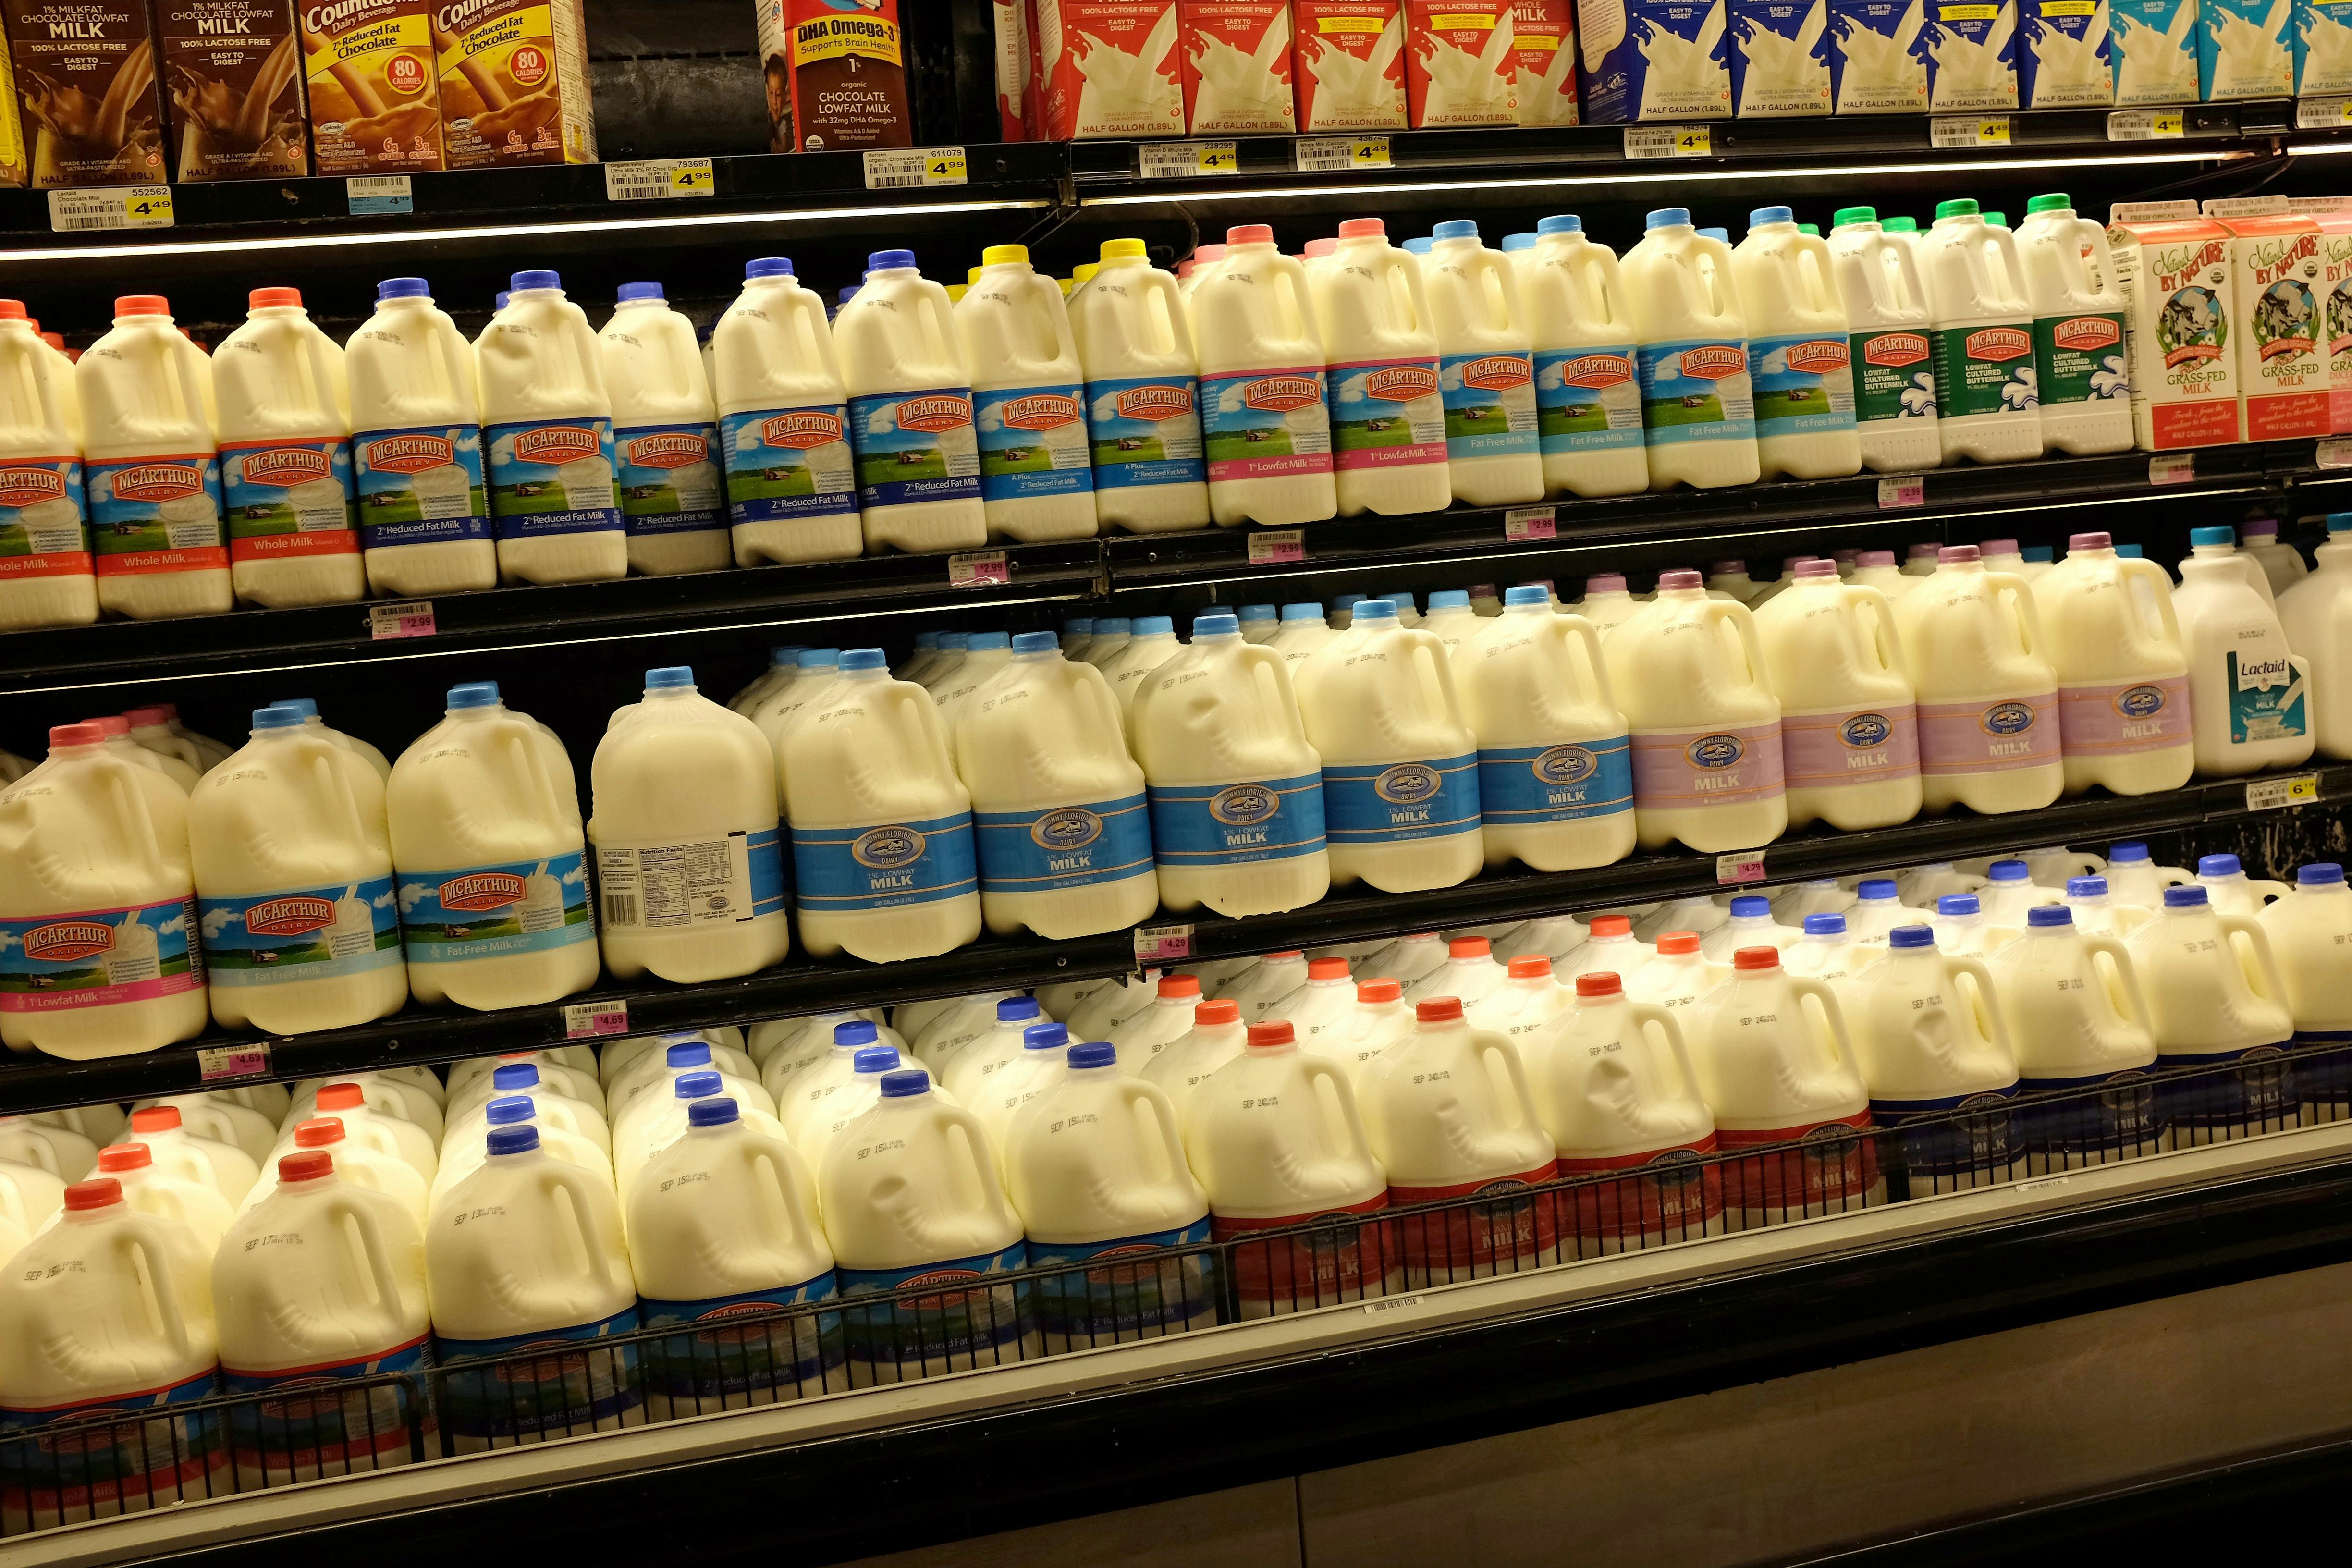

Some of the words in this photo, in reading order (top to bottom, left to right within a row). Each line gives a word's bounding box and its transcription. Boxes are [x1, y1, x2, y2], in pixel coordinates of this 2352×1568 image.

[59, 5, 104, 13] MILKFAT
[192, 2, 204, 11] 1%
[207, 1, 249, 10] MILKFAT
[21, 14, 84, 23] CHOCOLATE
[86, 14, 129, 22] LOWFAT
[172, 11, 232, 21] CHOCOLATE
[233, 10, 274, 18] LOWFAT
[332, 17, 357, 35] Dairy
[358, 6, 397, 21] Beverage
[1512, 9, 1546, 22] MILK
[49, 23, 105, 38] MILK
[197, 18, 251, 34] MILK
[798, 21, 829, 43] DHA
[831, 20, 894, 42] Omega-3
[343, 26, 383, 47] Reduced
[385, 24, 400, 34] Fat
[338, 37, 397, 59] Chocolate
[801, 39, 842, 54] Supports
[845, 38, 868, 47] Brain
[870, 39, 895, 53] Health
[518, 51, 537, 68] 80
[849, 59, 861, 72] 1%
[395, 60, 415, 77] 80
[515, 68, 543, 77] CALORIES
[392, 77, 421, 85] CALORIES
[819, 92, 885, 102] CHOCOLATE
[819, 104, 862, 114] LOWFAT
[866, 104, 891, 113] MILK
[868, 116, 896, 124] Omega-3
[1148, 123, 1176, 131] (1.89L)
[41, 175, 70, 184] HALF
[132, 188, 168, 196] 552562
[2160, 274, 2177, 291] BY
[2180, 242, 2225, 287] NATURE
[1864, 375, 1900, 383] CULTURED
[2168, 371, 2226, 385] GRASS-FED
[1865, 380, 1909, 390] BUTTERMILK
[2183, 384, 2211, 395] MILK
[1267, 398, 1301, 407] DAIRY
[1470, 439, 1484, 448] Fat
[1486, 437, 1504, 446] Free
[1507, 436, 1525, 445] Milk
[392, 459, 430, 468] DAIRY
[1257, 460, 1288, 471] Lowfat
[1289, 458, 1308, 468] Milk
[1027, 480, 1053, 489] Reduced
[1064, 478, 1077, 486] Milk
[386, 523, 425, 534] Reduced
[427, 522, 440, 531] Fat
[441, 520, 460, 529] Milk
[124, 556, 159, 567] Whole
[162, 554, 185, 564] Milk
[2242, 659, 2285, 676] Lactaid
[1696, 737, 1714, 748] SUNNY
[1715, 736, 1736, 745] FLORIDA
[1694, 774, 1740, 791] MILK
[1043, 813, 1063, 826] SUNNY
[1065, 812, 1089, 821] FLORIDA
[865, 831, 885, 845] SUNNY
[887, 830, 912, 840] FLORIDA
[882, 856, 898, 865] DAIRY
[1050, 856, 1091, 871] MILK
[883, 868, 915, 877] LOWFAT
[871, 875, 913, 889] MILK
[463, 897, 503, 906] DAIRY
[47, 946, 90, 956] DAIRY
[447, 946, 463, 956] Fat
[465, 944, 488, 954] Free
[490, 940, 512, 951] Milk
[38, 995, 73, 1006] Lowfat
[75, 992, 98, 1004] Milk
[1740, 1017, 1752, 1026] SEP
[1243, 1099, 1254, 1109] SEP
[1050, 1121, 1064, 1134] SEP
[245, 1238, 259, 1252] SEP
[24, 1271, 42, 1281] SEP
